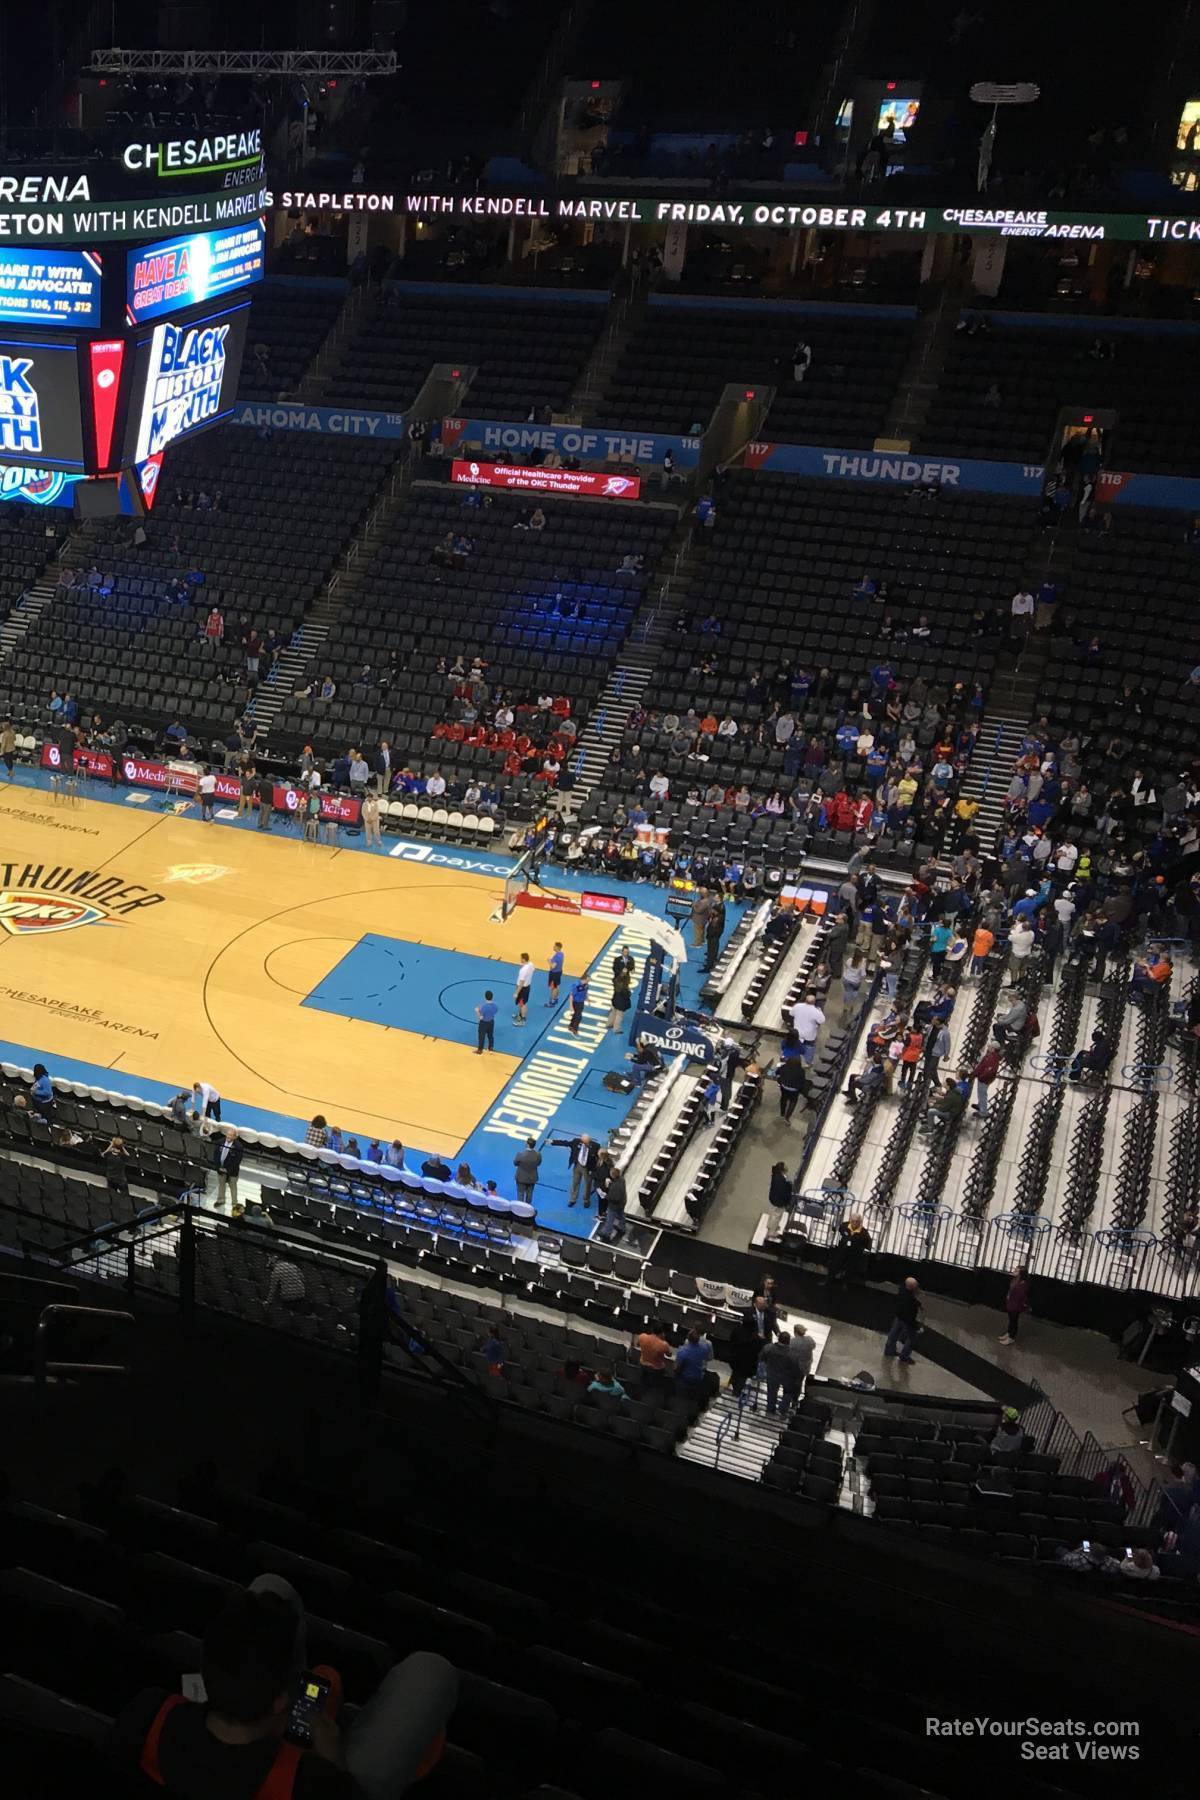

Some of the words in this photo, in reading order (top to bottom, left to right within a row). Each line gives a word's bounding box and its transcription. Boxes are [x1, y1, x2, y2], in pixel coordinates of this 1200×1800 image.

[124, 129, 261, 169] CHESAPEAKE
[224, 166, 260, 189] ENERGY
[73, 211, 126, 232] WITH
[133, 204, 212, 229] KENDELL
[215, 194, 257, 219] MARVEL
[282, 192, 394, 211] STAPLETON
[407, 195, 454, 213] WITH
[462, 197, 550, 216] KENDELL
[559, 200, 642, 220] MARVEL
[657, 203, 745, 225] FRIDAY,
[754, 206, 867, 226] OCTOBER
[876, 210, 926, 229] 4TH
[943, 209, 1048, 224] CHESAPEAKE
[1001, 227, 1044, 237] ENERGY
[1044, 225, 1105, 239] ARENA
[31, 265, 46, 278] IT
[47, 265, 83, 281] WITH
[133, 253, 177, 290] HAVE
[177, 250, 189, 278] A
[18, 278, 92, 295] ADVOCATE!
[133, 286, 164, 310] GREAT
[159, 323, 230, 375] BLACK
[328, 415, 381, 434] CITY
[386, 415, 402, 425] 115
[445, 421, 461, 430] 116
[484, 427, 556, 449] HOME
[563, 434, 598, 453] OF
[604, 436, 655, 459] THE
[681, 438, 700, 449] 116
[749, 443, 769, 455] 117
[457, 474, 491, 484] Medicine
[494, 467, 521, 476] Official
[522, 470, 562, 480] Healthcare
[563, 473, 595, 483] Provider
[823, 454, 961, 485] THUNDER
[1023, 466, 1044, 478] 117
[1101, 473, 1122, 485] 118
[507, 477, 515, 485] of
[516, 478, 529, 486] the
[530, 480, 548, 488] OKC
[549, 480, 581, 490] Thunder
[47, 822, 100, 837] ARENA
[427, 853, 513, 876] payco
[1, 863, 166, 915] THUNDER
[644, 965, 656, 1004] DRAFTKINGS
[97, 1019, 160, 1041] ARENA
[484, 1051, 589, 1141] THUNDER
